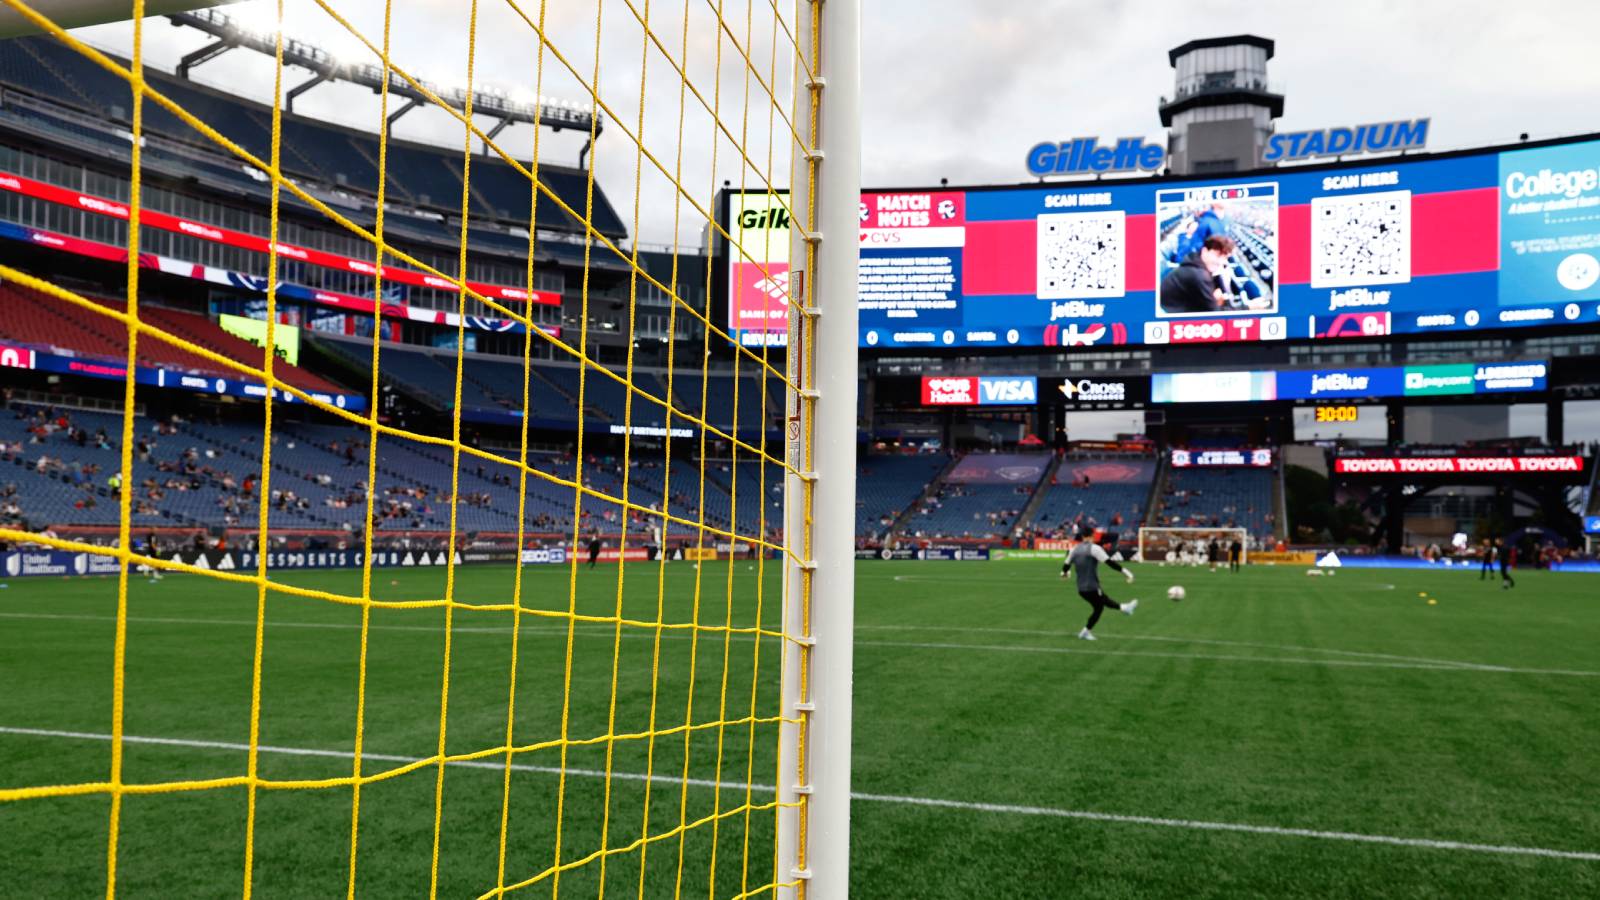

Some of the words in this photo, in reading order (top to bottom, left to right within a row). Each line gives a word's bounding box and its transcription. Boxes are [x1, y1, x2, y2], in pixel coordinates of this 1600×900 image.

[1027, 136, 1167, 176] Gillette
[1264, 119, 1431, 162] STADIUM
[1323, 175, 1359, 190] SCAN
[1361, 171, 1398, 187] HERE
[1505, 169, 1597, 199] College
[877, 195, 930, 210] MATCH
[1045, 194, 1077, 207] SCAN
[1079, 192, 1111, 206] HERE
[878, 211, 930, 227] NOTES
[871, 231, 901, 243] CVS
[1329, 288, 1391, 311] jetBlue
[1050, 301, 1105, 321] jetBlue
[1153, 326, 1162, 339] 0
[1174, 324, 1222, 338] 30:00
[1268, 321, 1279, 335] 0
[943, 380, 970, 391] CVS
[981, 381, 1035, 401] VISA
[1311, 373, 1369, 394] jetBlue
[1317, 406, 1356, 422] 30:00
[1341, 459, 1395, 472] TOYOTA
[1399, 459, 1454, 471] TOYOTA
[1457, 458, 1515, 471] TOYOTA
[1518, 457, 1577, 471] TOYOTA
